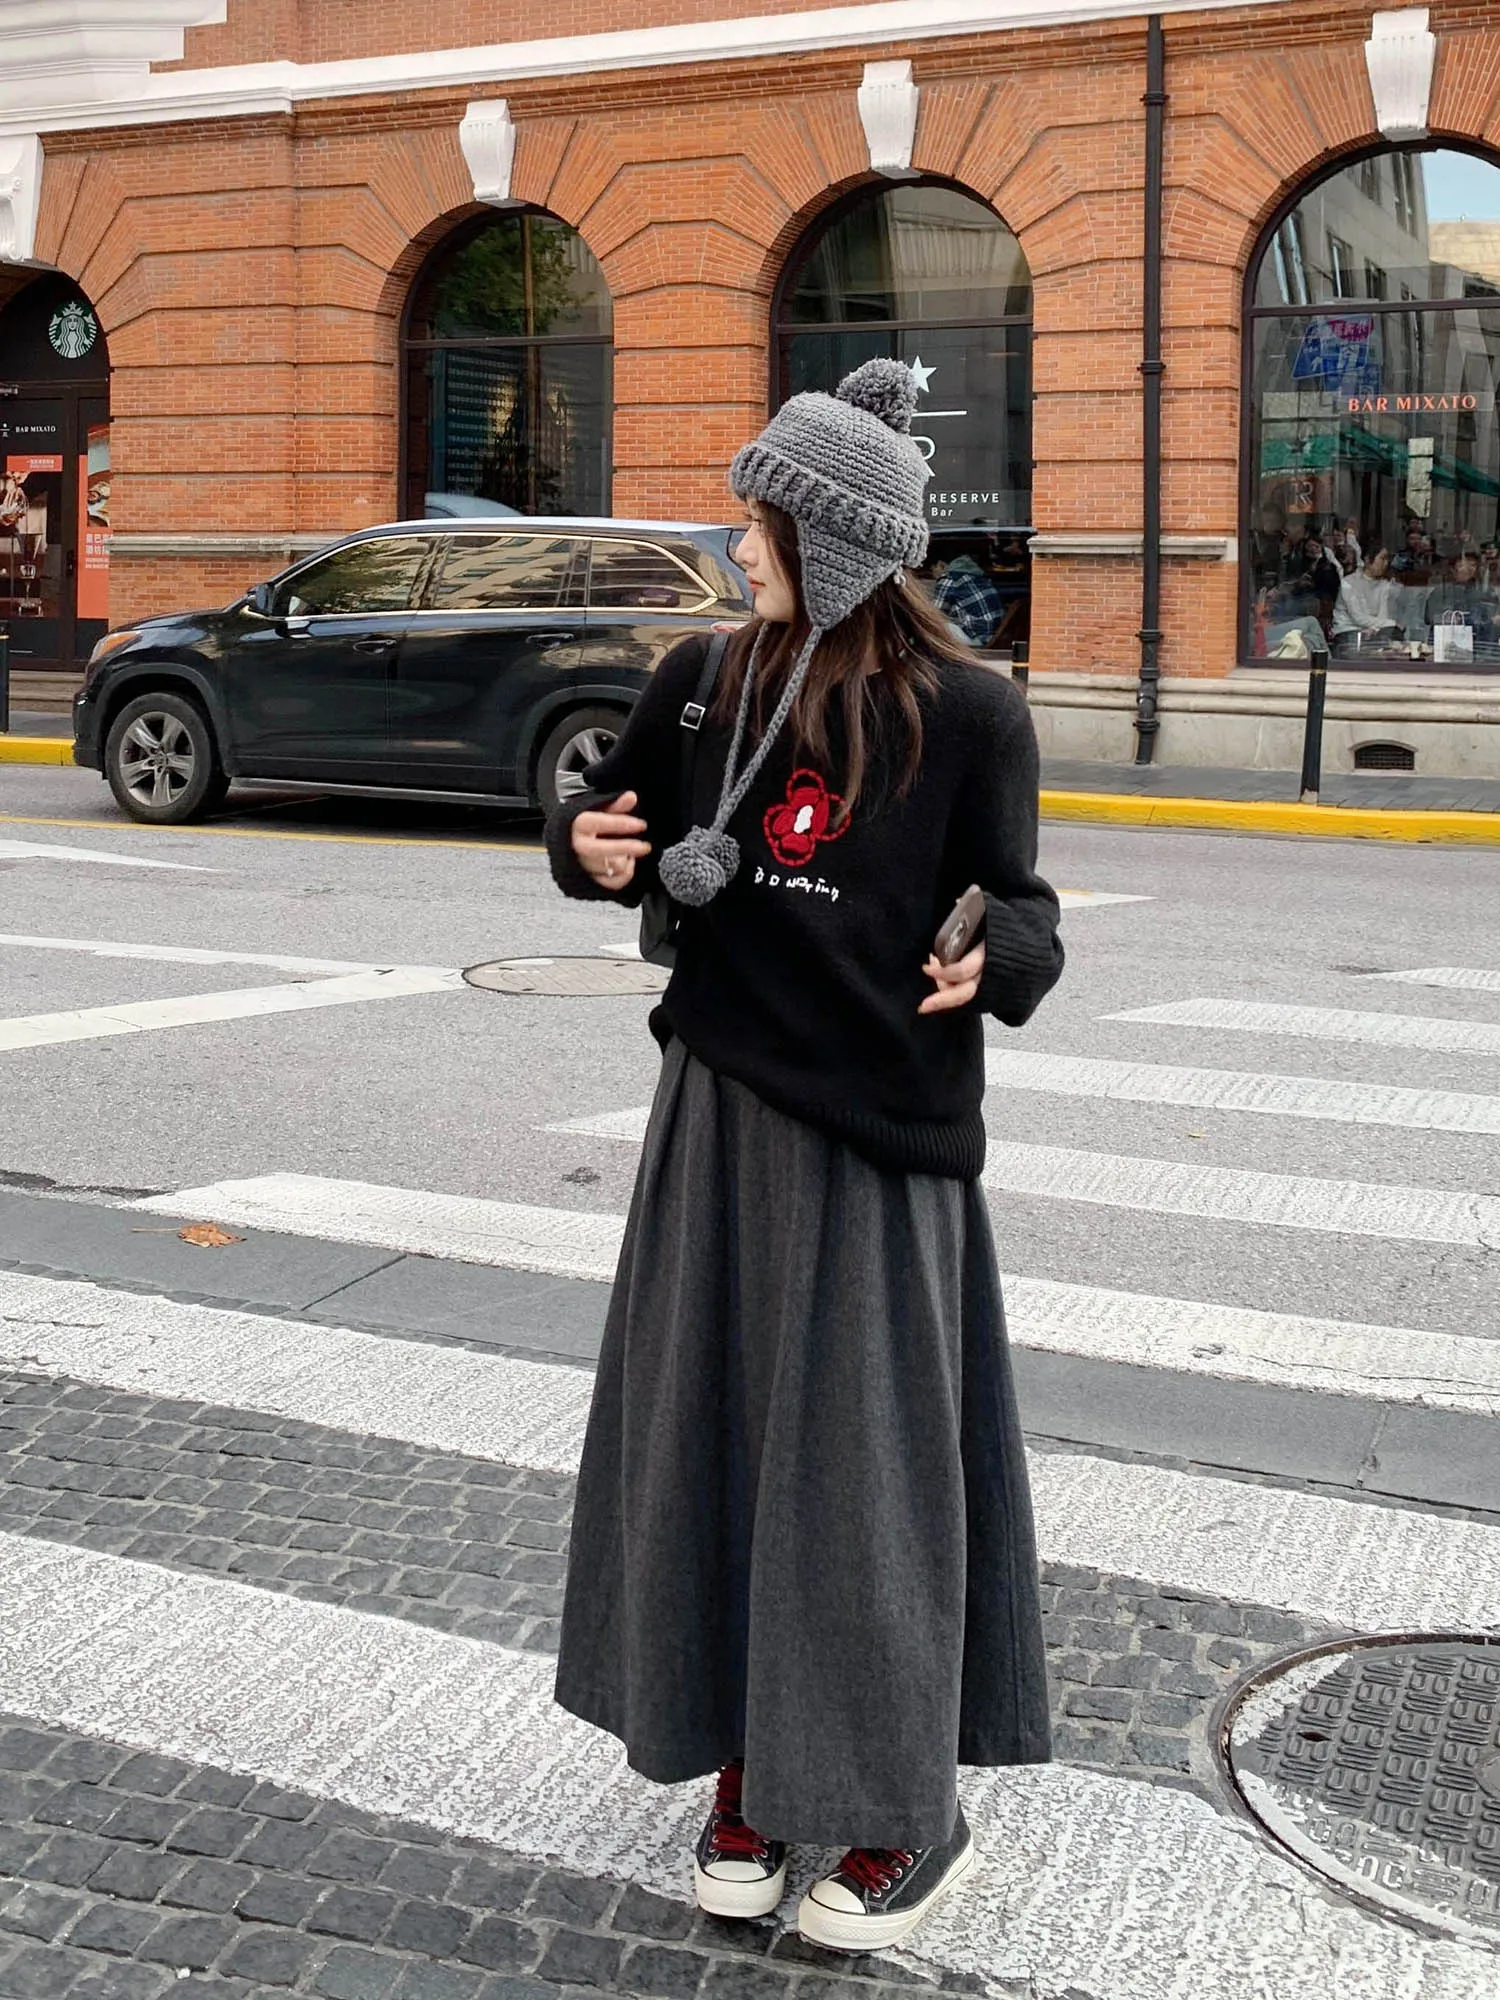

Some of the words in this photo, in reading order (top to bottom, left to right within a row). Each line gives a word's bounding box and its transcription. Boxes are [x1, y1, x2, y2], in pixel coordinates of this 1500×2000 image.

[1348, 398, 1388, 412] BAR
[1396, 394, 1477, 410] MIXATO
[30, 425, 56, 433] MIXATO
[929, 492, 1000, 504] RESERVE
[931, 507, 954, 517] Bar
